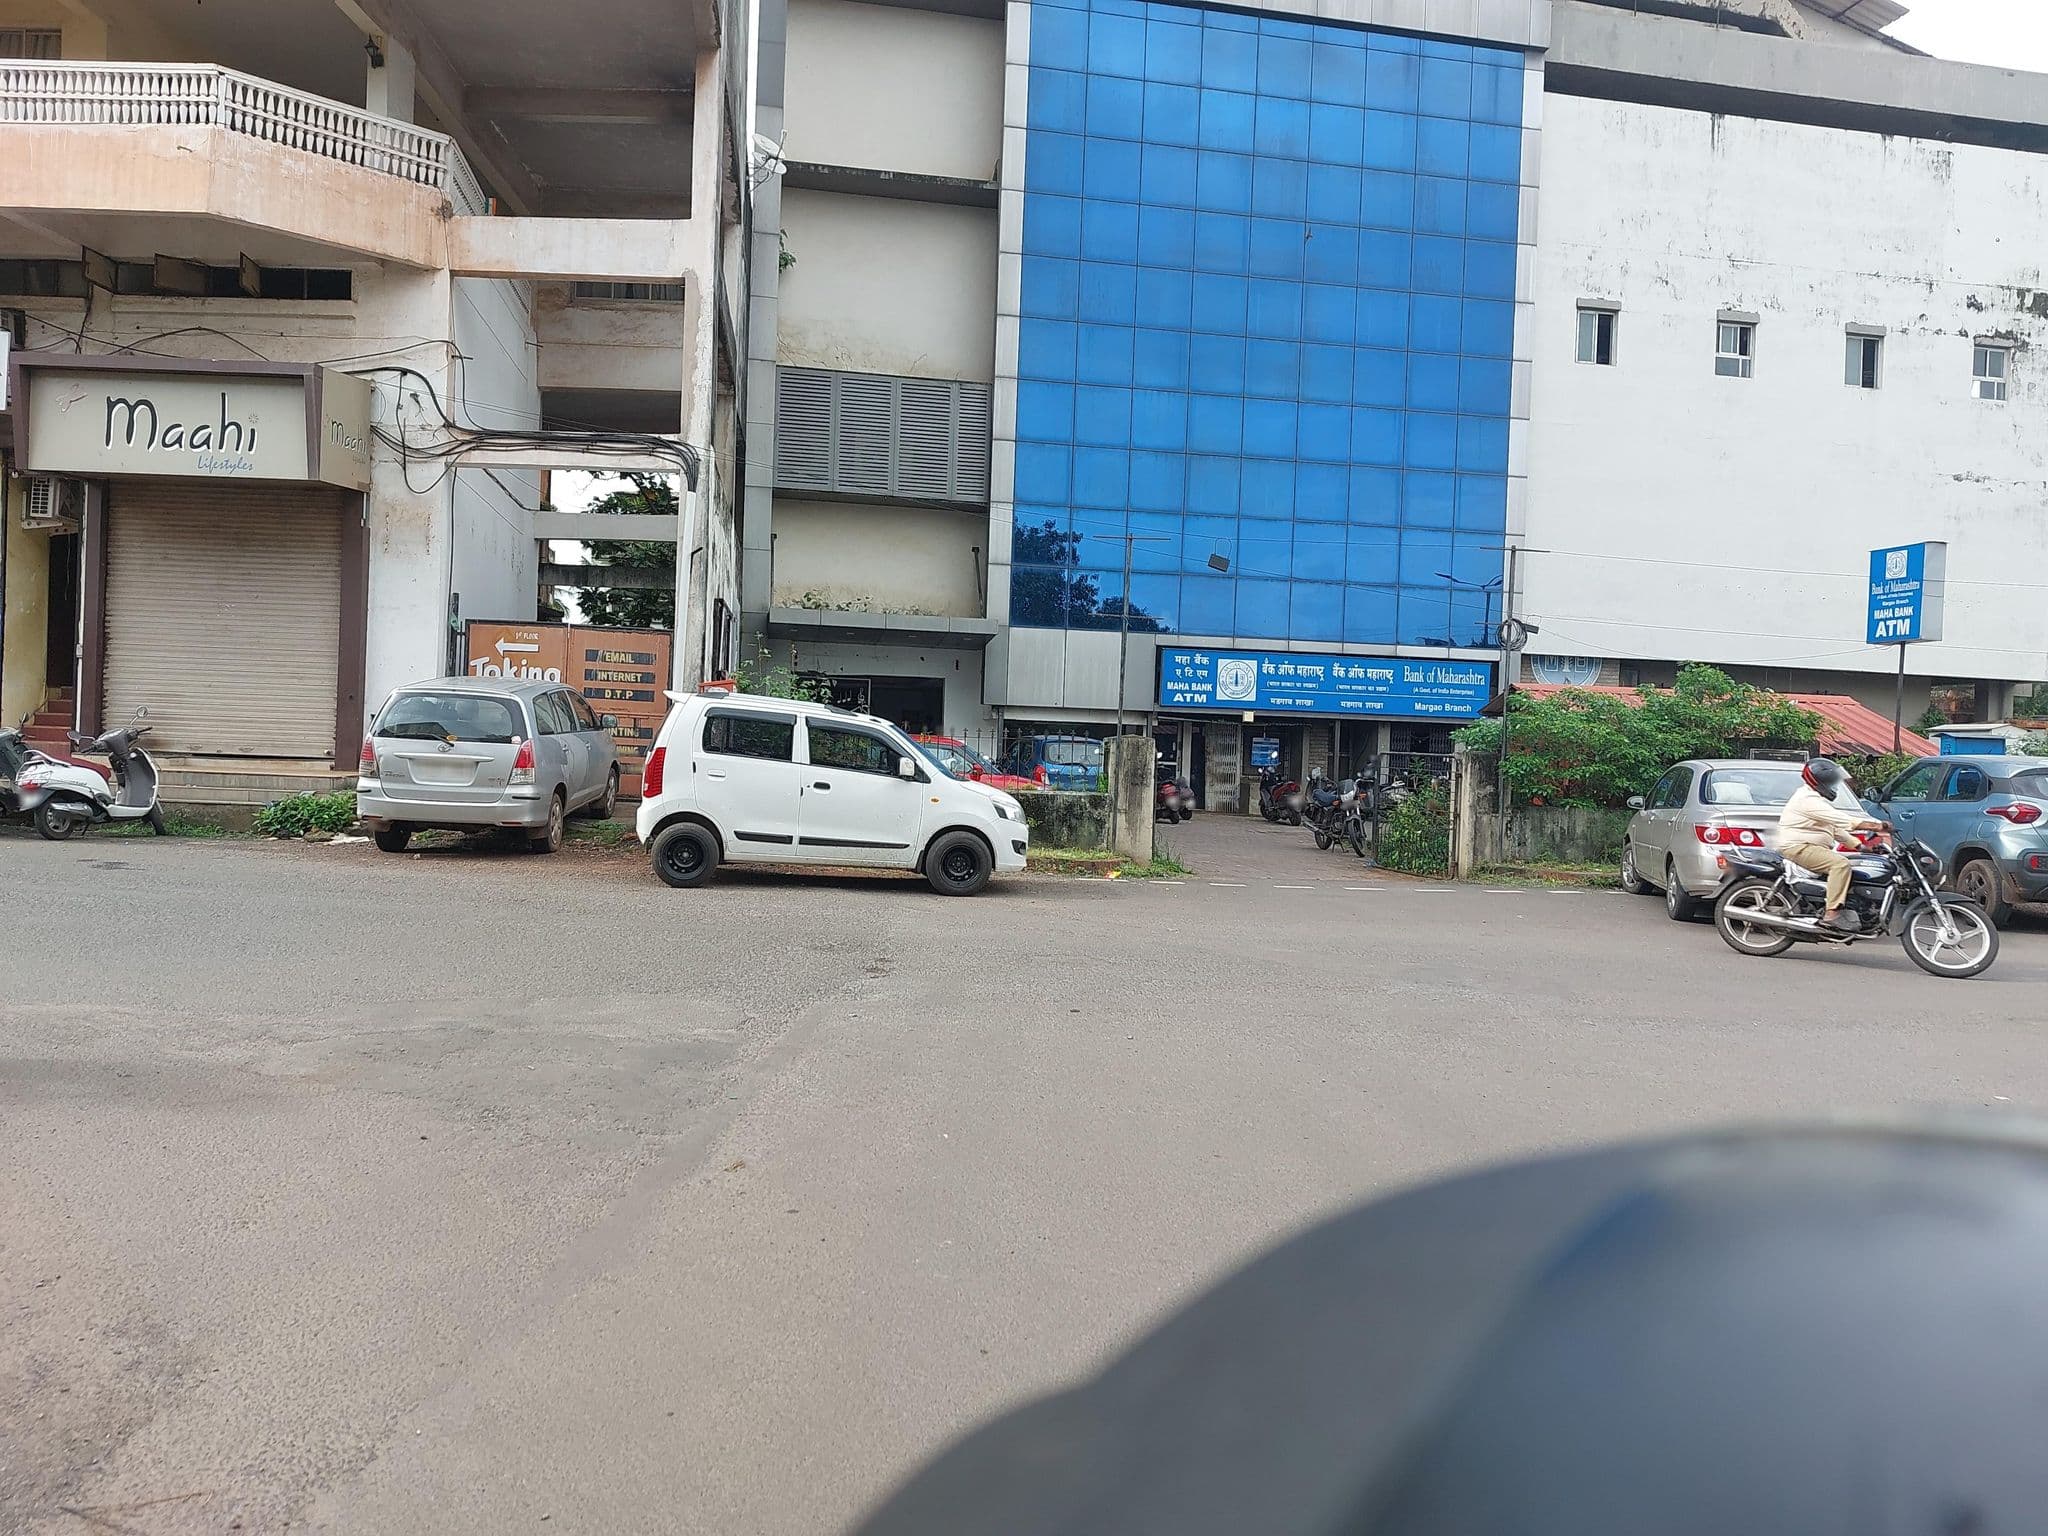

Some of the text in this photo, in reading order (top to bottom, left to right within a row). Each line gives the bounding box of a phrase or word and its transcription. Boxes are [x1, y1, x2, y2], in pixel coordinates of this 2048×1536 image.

[1874, 606, 1914, 620] MAHA BANK
[1875, 619, 1911, 638] ATM
[605, 652, 635, 664] EMAIL
[1174, 655, 1191, 665] महा
[597, 671, 643, 683] INTERNET
[1403, 665, 1485, 686] Bank of Maharashtra
[1167, 681, 1213, 692] MAHA BANK
[604, 689, 634, 700] D.T.P
[1173, 692, 1207, 703] ATM
[1414, 702, 1472, 713] Margao Branch
